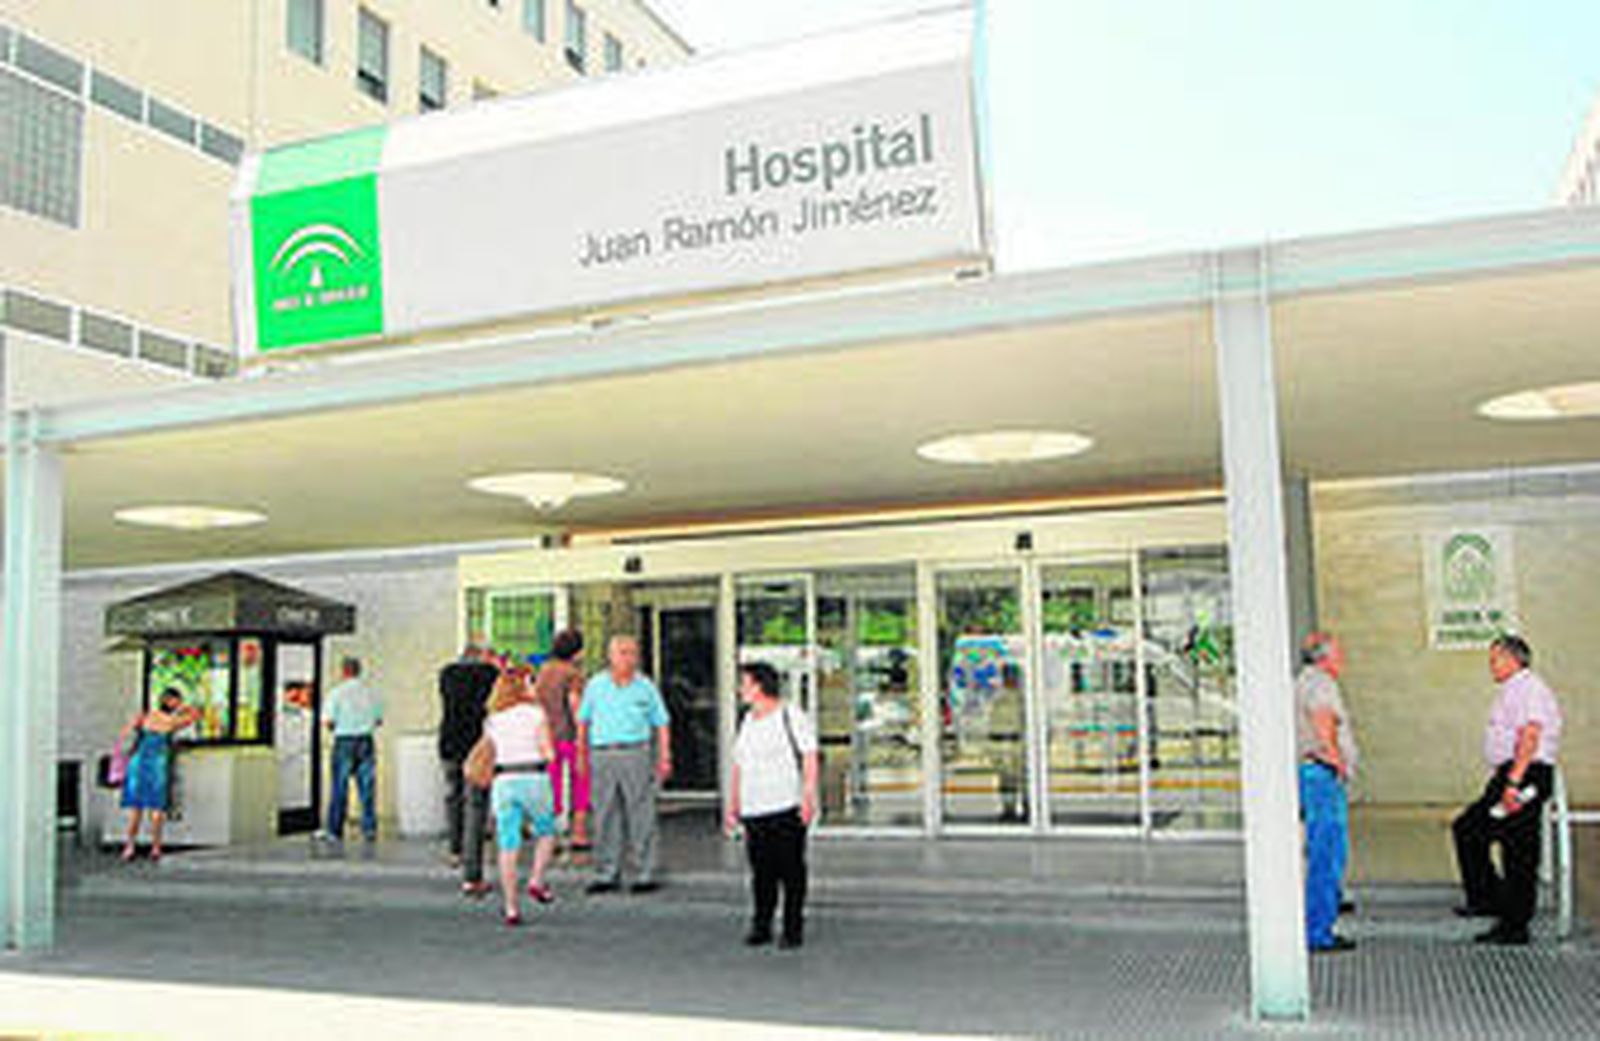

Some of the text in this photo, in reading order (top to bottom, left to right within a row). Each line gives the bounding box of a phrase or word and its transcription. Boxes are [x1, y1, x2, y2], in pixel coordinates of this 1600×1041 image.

[724, 113, 934, 196] Hospital
[578, 184, 938, 267] Juan Ramón Jiménez
